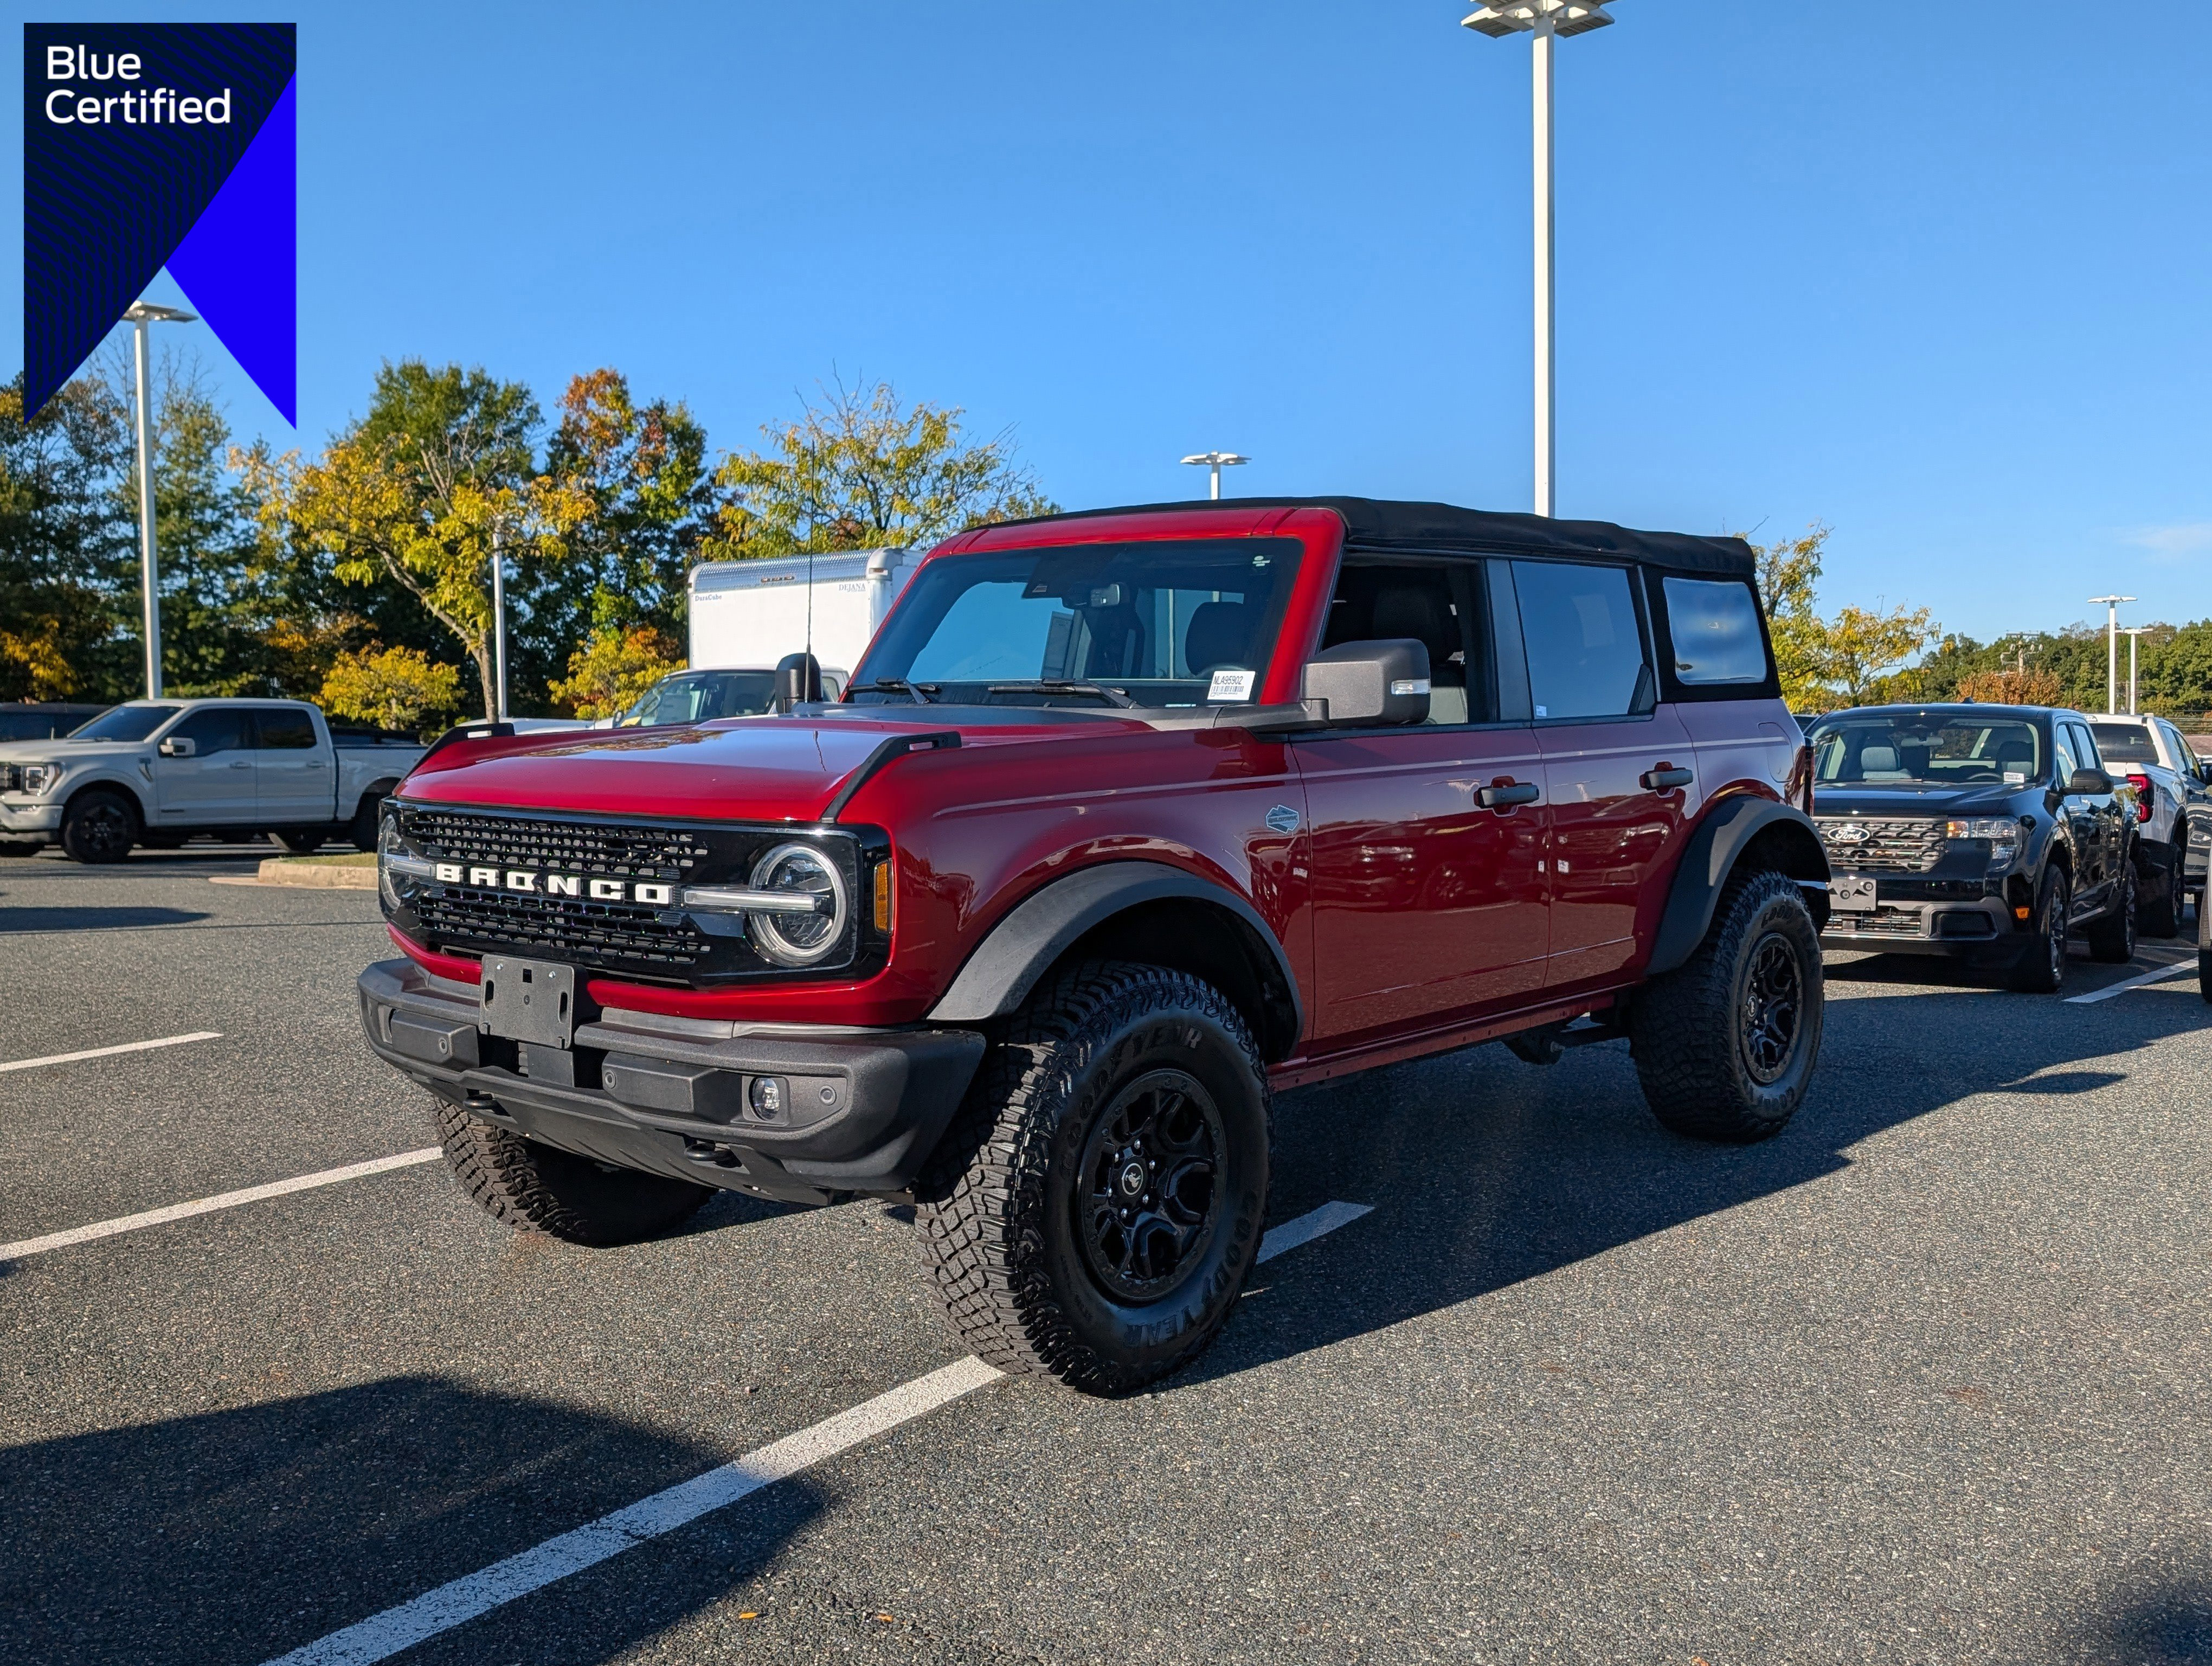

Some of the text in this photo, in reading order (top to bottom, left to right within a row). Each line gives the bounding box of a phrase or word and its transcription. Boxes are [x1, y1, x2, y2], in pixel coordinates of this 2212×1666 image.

[838, 583, 866, 591] DEJANA
[1213, 676, 1243, 685] NLA95902
[1835, 828, 1862, 840] Ford
[436, 863, 673, 905] BRONCO
